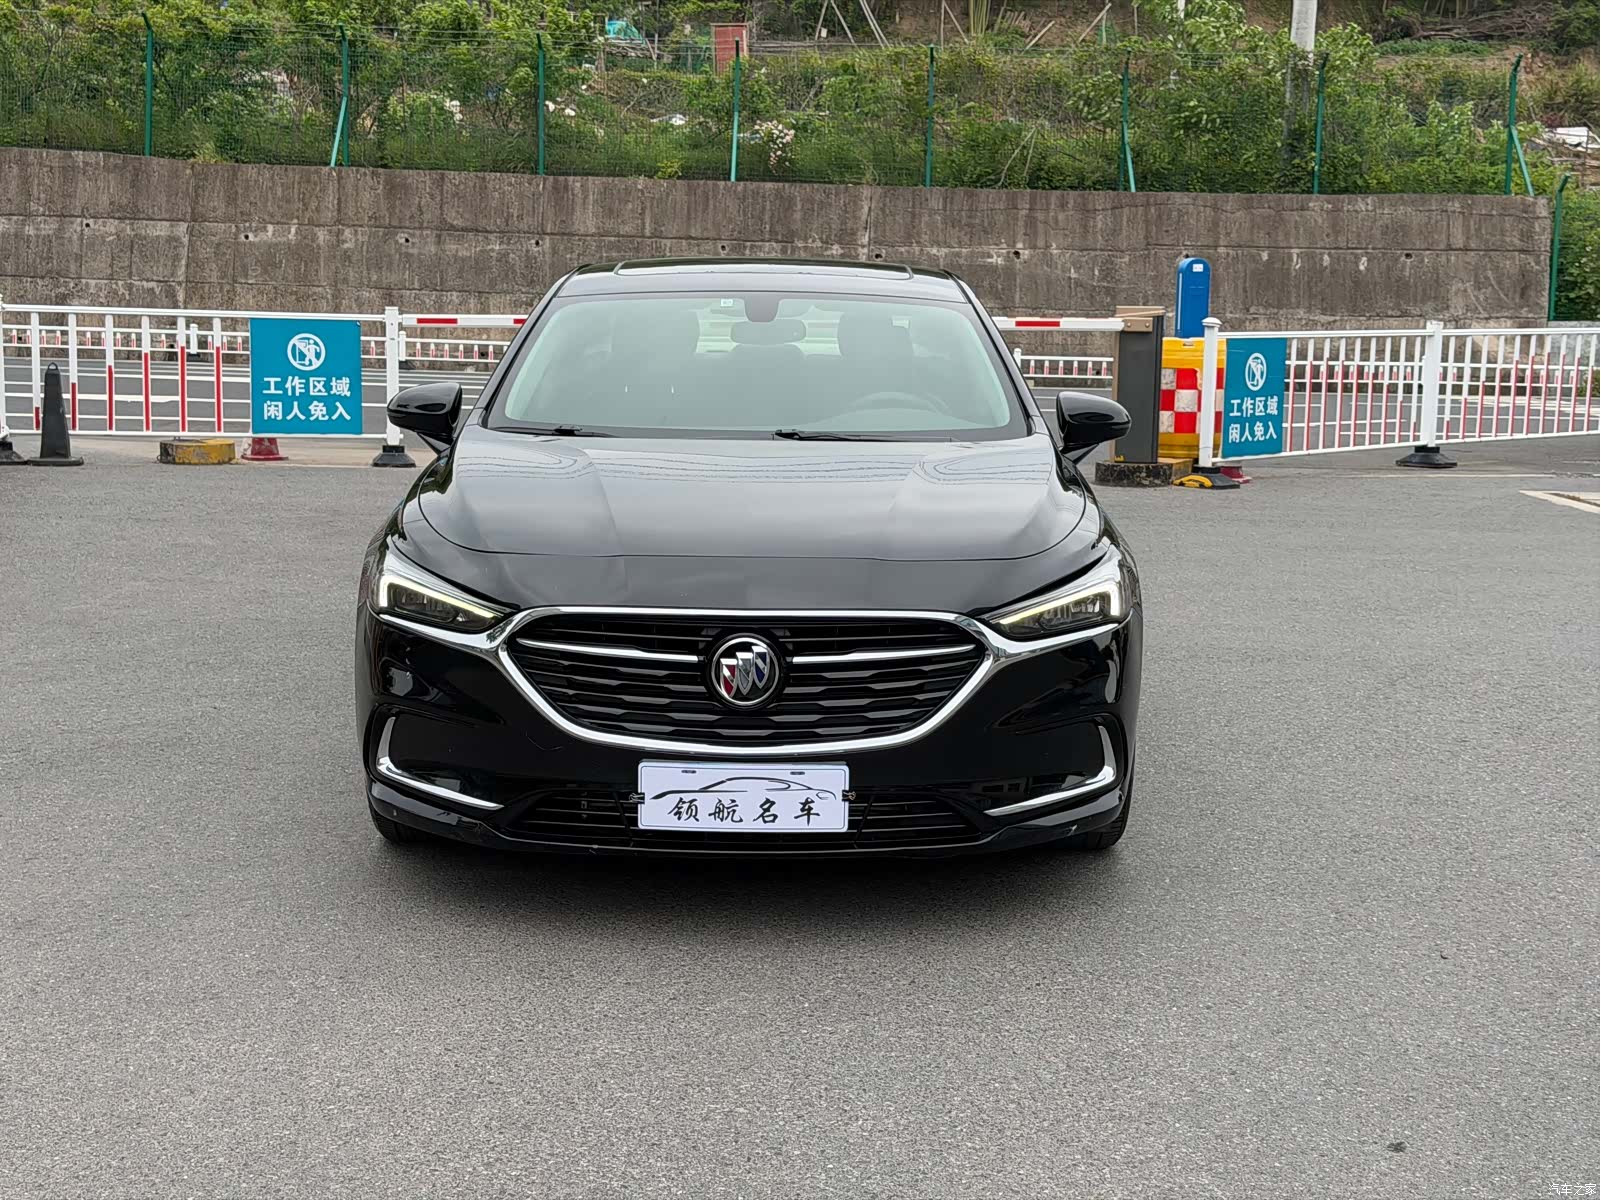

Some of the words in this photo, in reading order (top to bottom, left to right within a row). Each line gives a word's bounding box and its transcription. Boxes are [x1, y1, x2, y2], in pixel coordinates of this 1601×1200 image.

[262, 376, 351, 397] 工作区域
[263, 400, 351, 420] 闲人免入
[1229, 395, 1279, 417] 工作区域
[1228, 421, 1277, 443] 闲人免入
[667, 797, 821, 826] 领航名车
